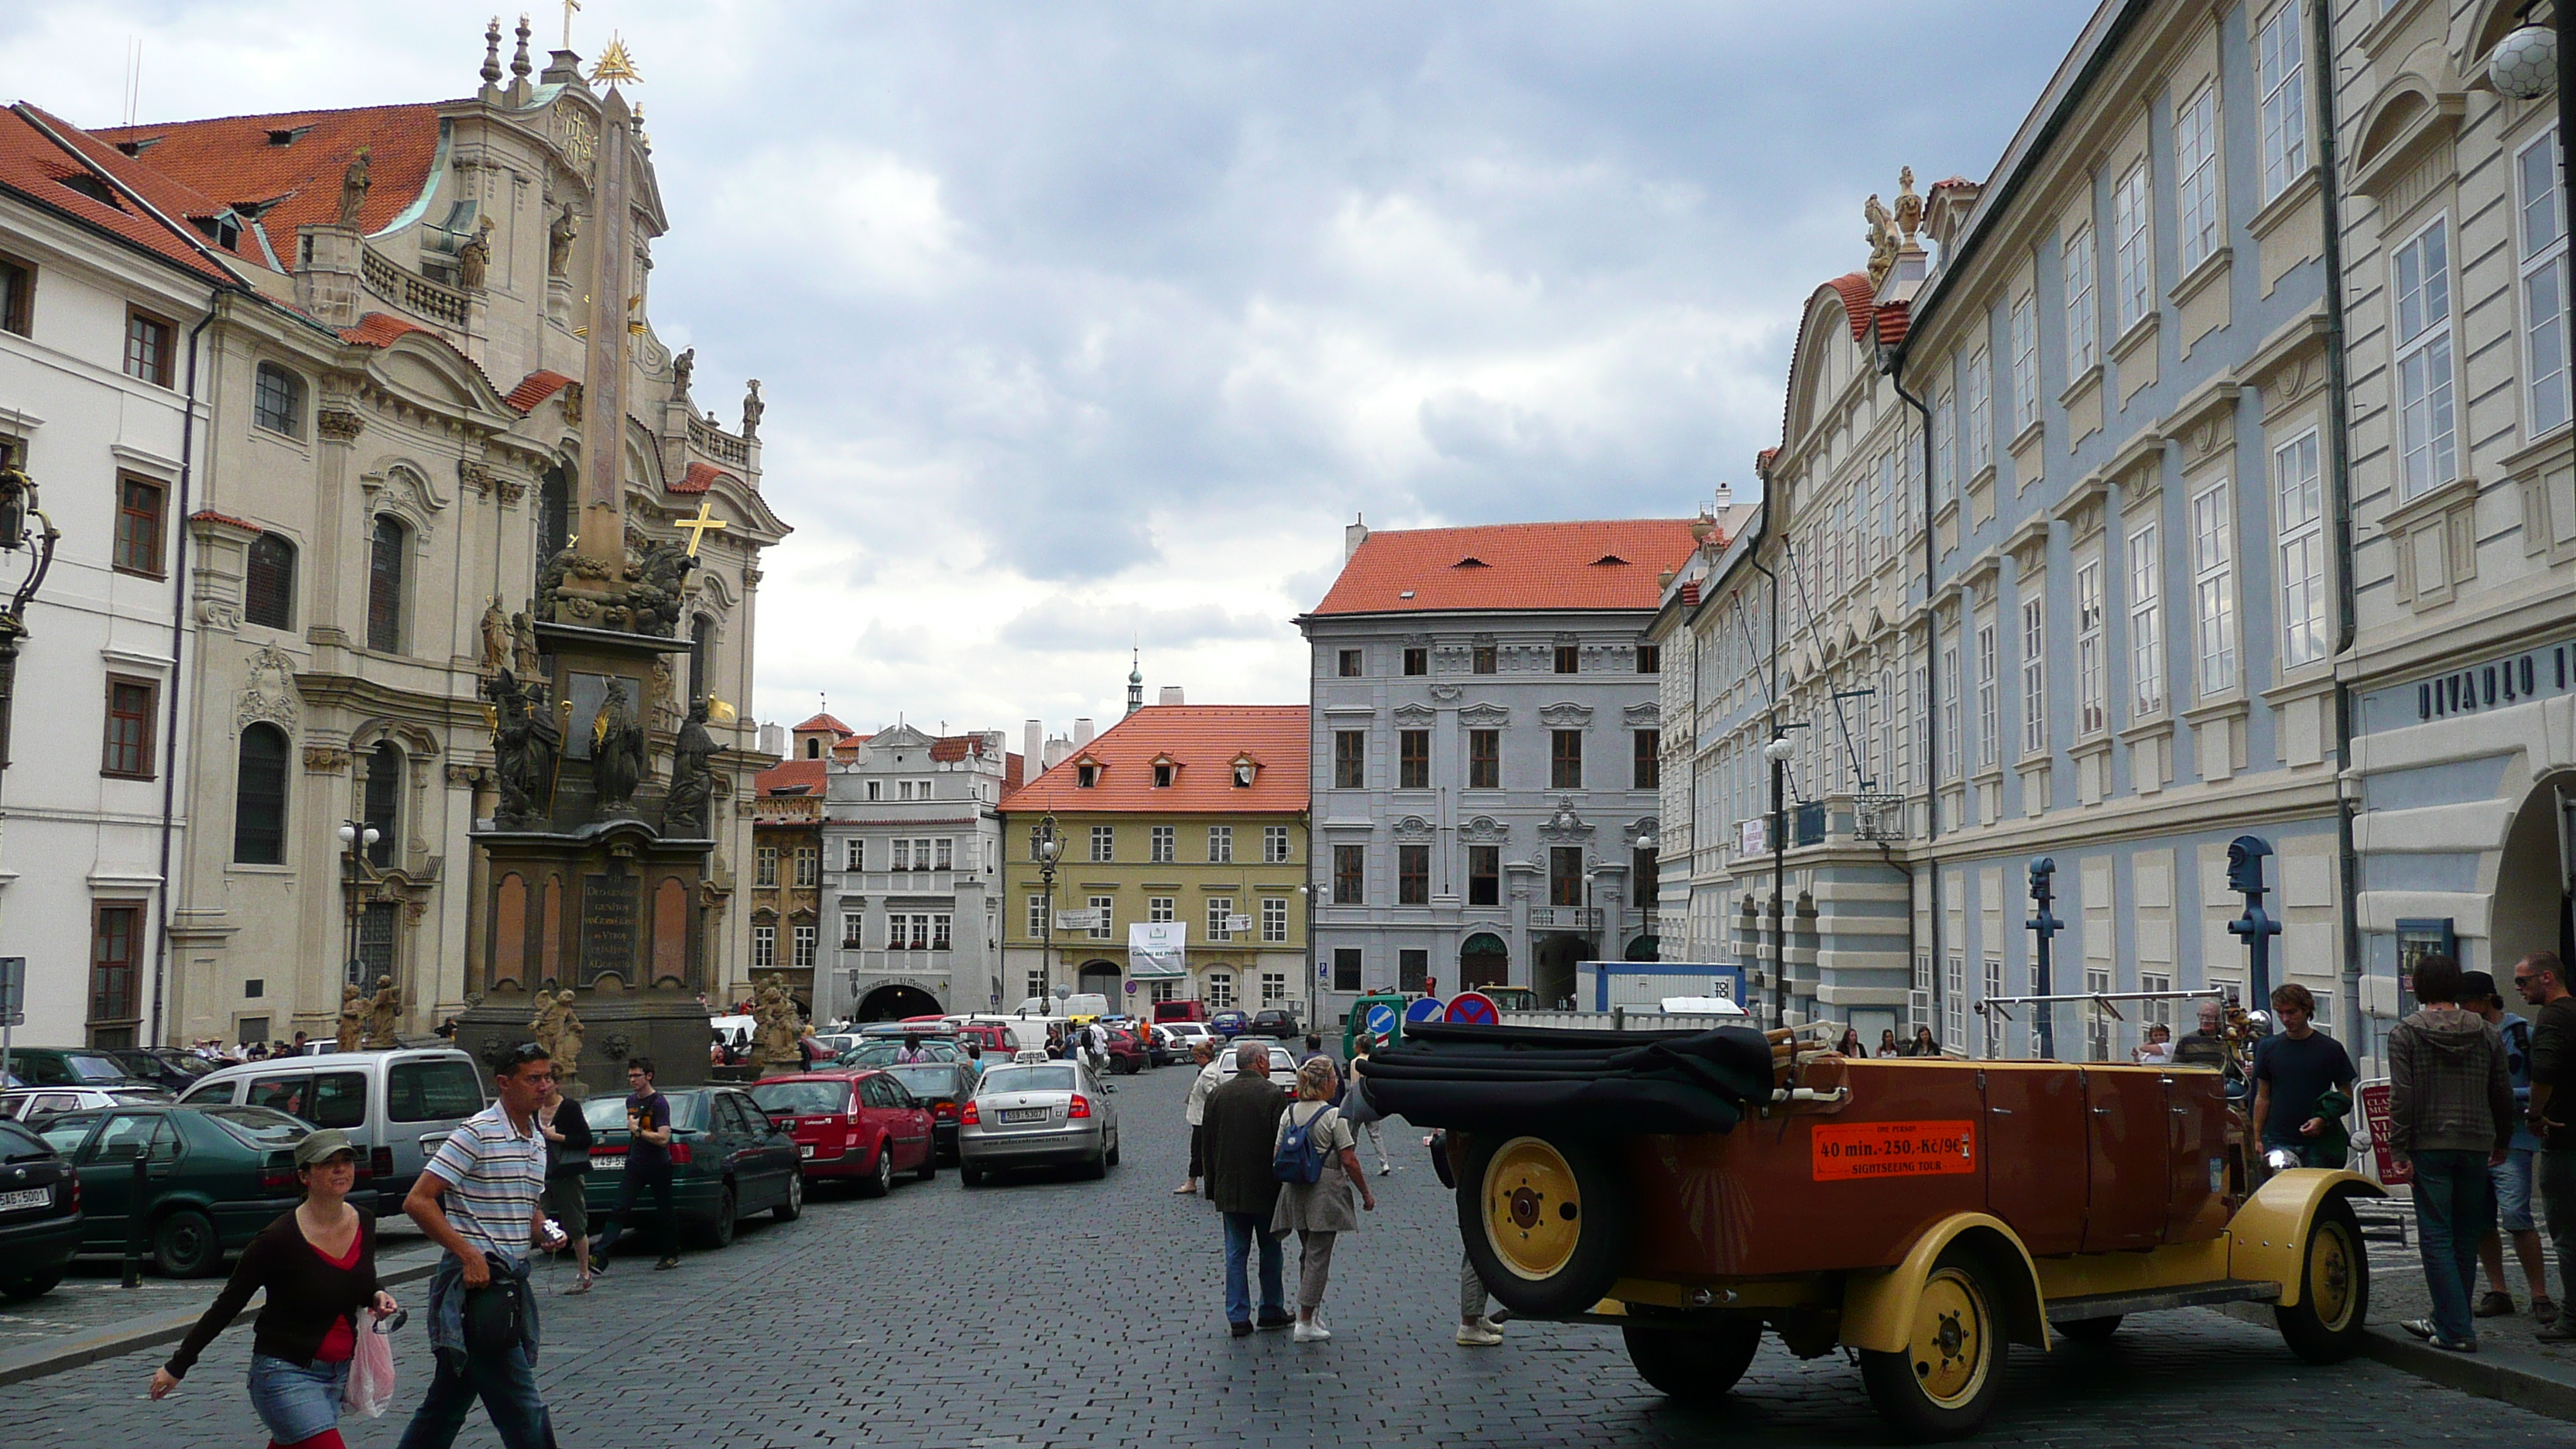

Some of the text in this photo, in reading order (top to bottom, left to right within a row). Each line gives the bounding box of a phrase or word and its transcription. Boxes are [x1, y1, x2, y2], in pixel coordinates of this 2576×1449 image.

[2418, 655, 2534, 719] DIVADLO
[1821, 1142, 1840, 1157] 40
[1852, 1161, 1942, 1174] SIGHTSEEING TOUR
